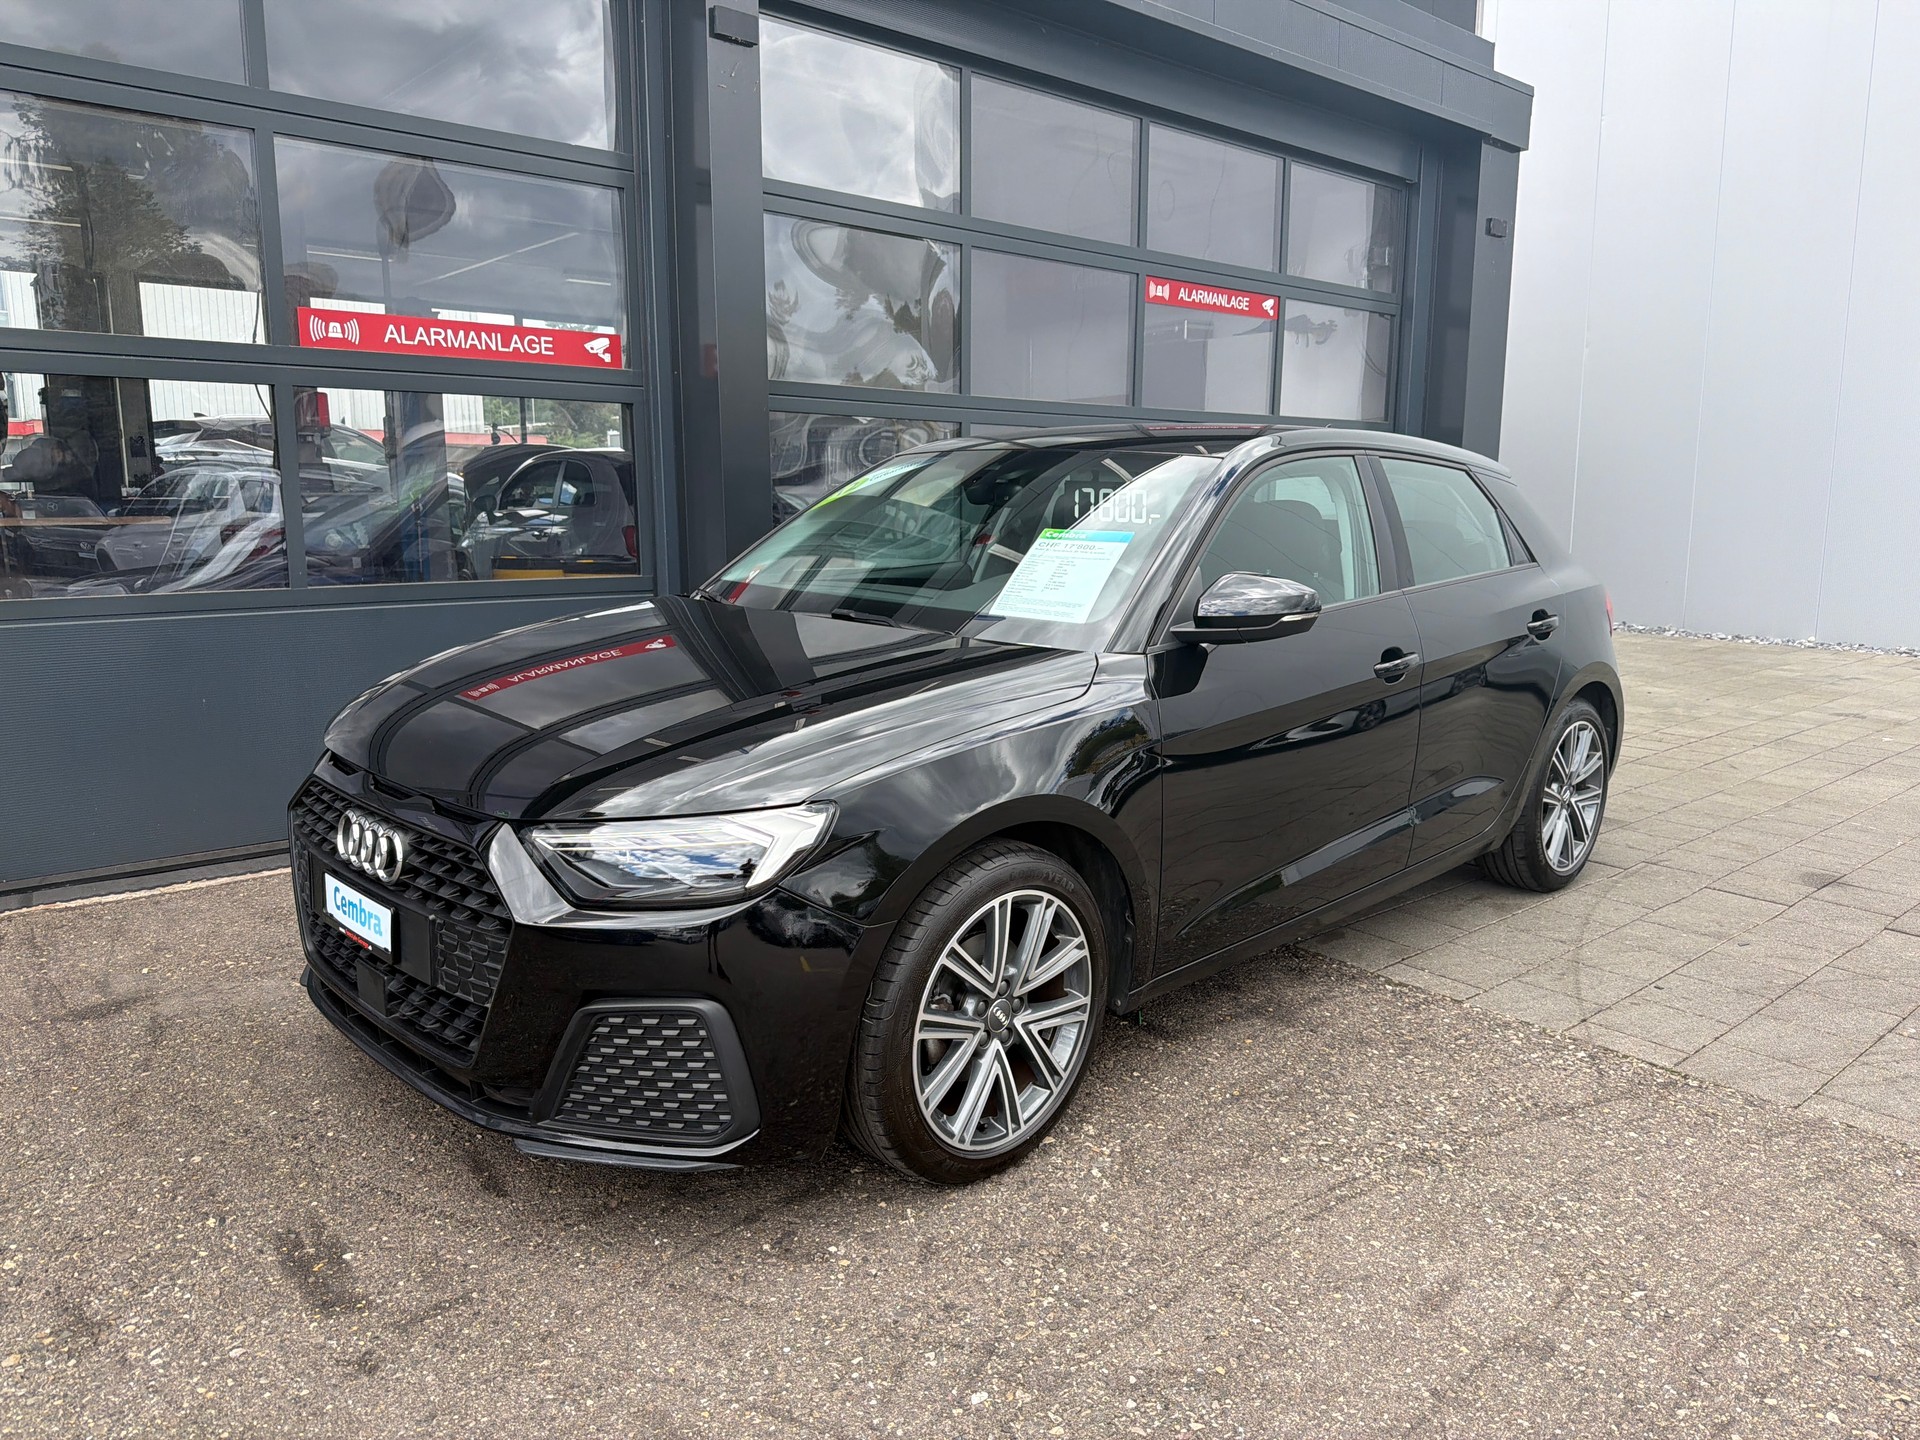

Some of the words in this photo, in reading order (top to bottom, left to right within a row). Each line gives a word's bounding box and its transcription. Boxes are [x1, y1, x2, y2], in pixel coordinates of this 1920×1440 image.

[1178, 287, 1250, 311] ALARMANLAGE
[384, 324, 554, 355] ALARMANLAGE
[1038, 541, 1062, 549] CHF
[1045, 531, 1086, 539] Cembra
[333, 885, 383, 937] Cembra
